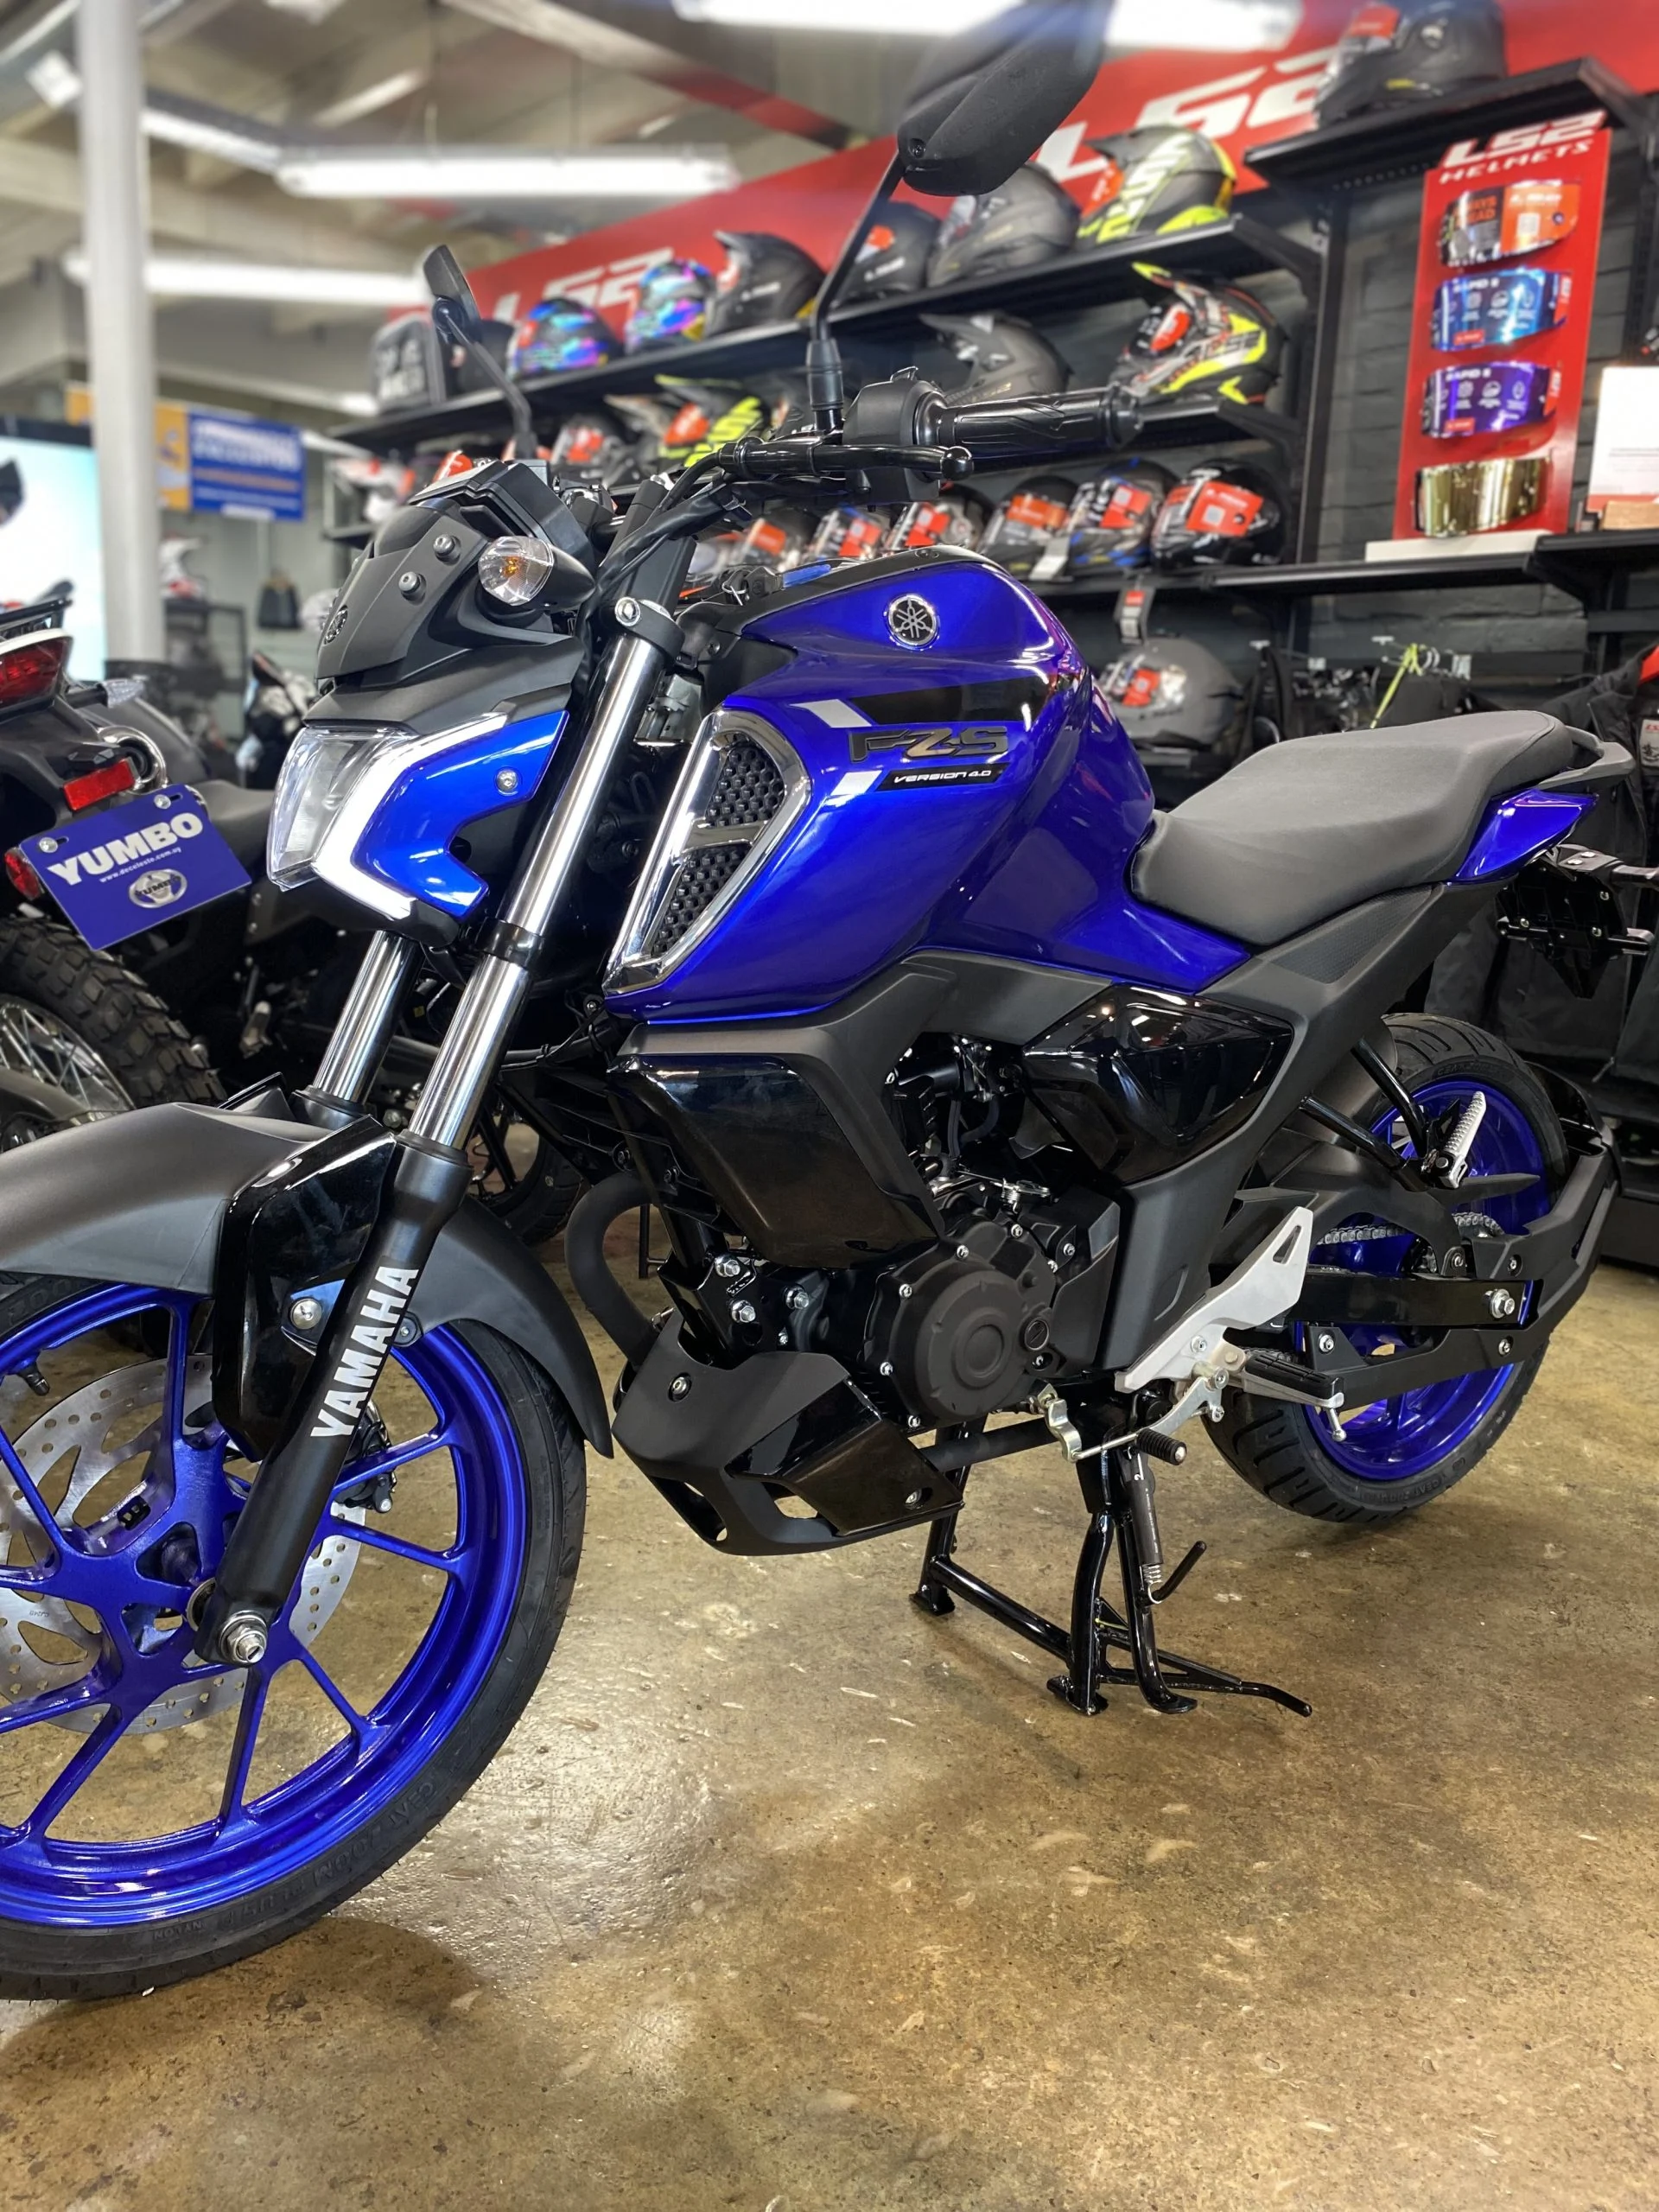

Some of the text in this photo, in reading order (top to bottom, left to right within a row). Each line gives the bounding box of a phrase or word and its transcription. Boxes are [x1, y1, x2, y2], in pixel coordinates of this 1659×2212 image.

[1439, 139, 1594, 184] HELMETS
[1444, 109, 1606, 168] LS2
[47, 812, 204, 887] YUMBO
[310, 1266, 420, 1437] YAMAHA
